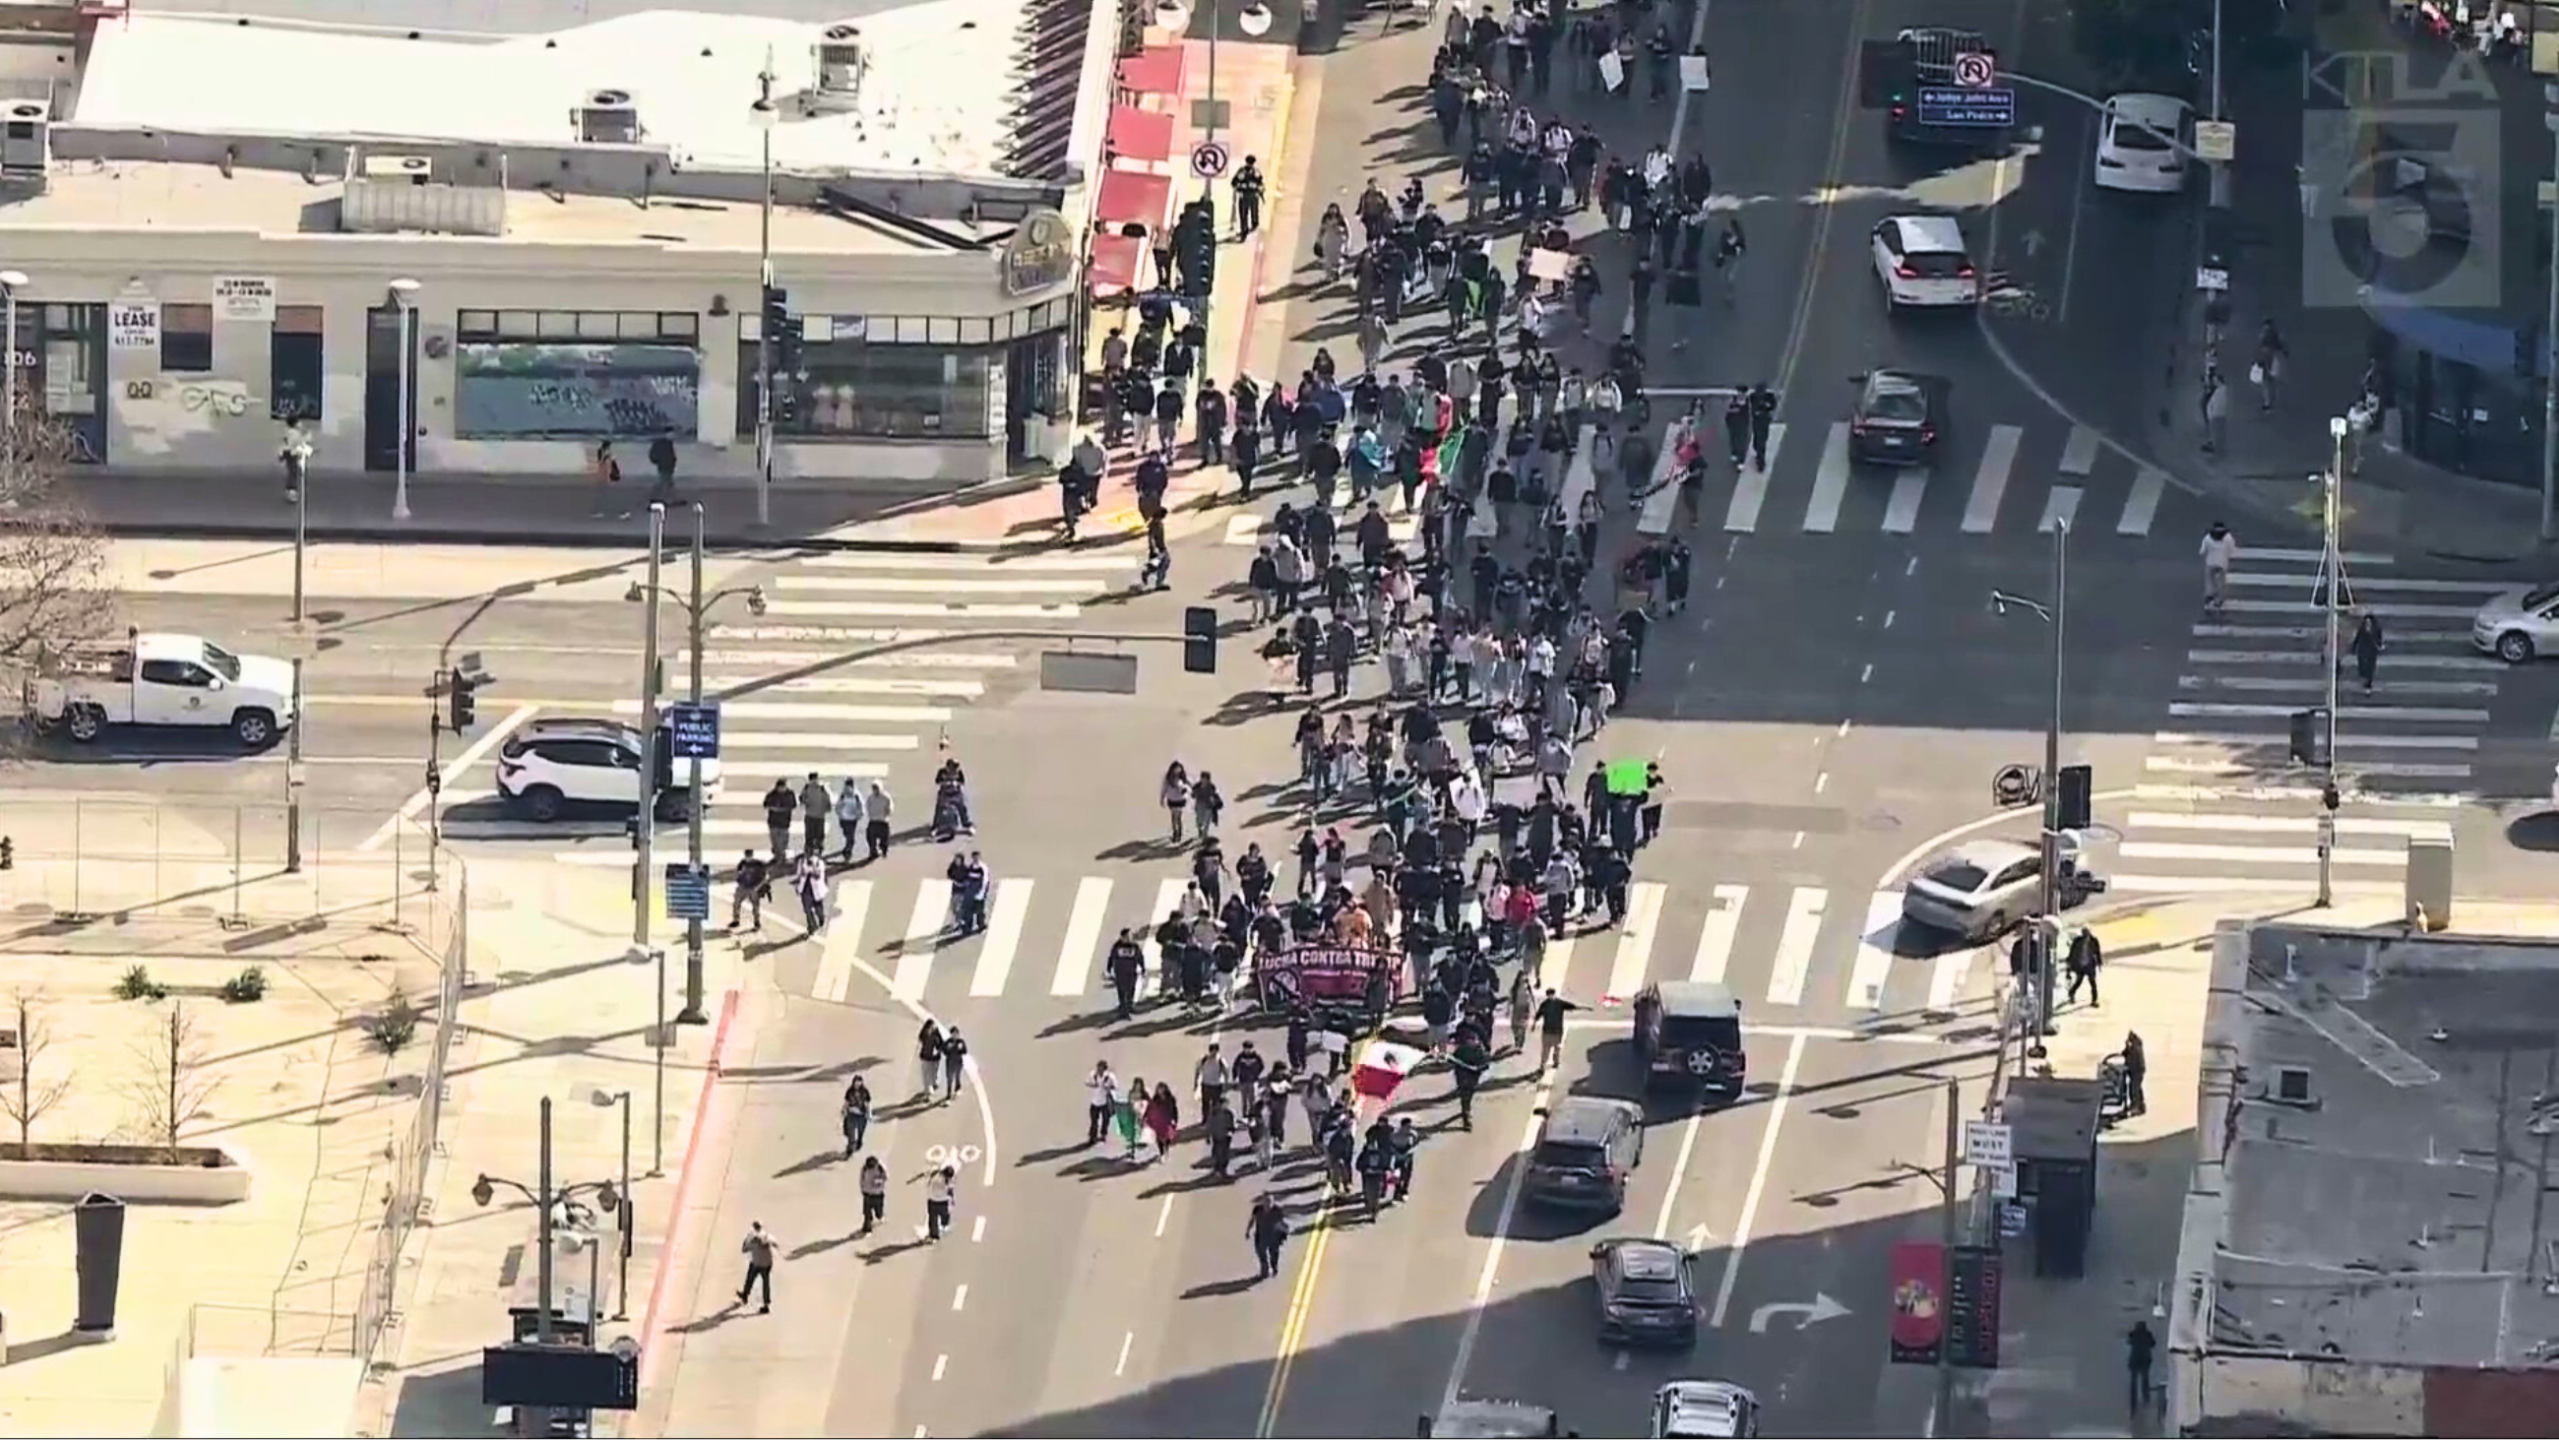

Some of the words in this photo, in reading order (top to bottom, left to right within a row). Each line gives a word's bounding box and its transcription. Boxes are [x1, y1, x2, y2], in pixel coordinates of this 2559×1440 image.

[114, 312, 156, 327] LEASE
[4, 351, 37, 366] 06
[678, 722, 711, 733] PUBLIC
[675, 732, 716, 743] PARKING
[1259, 953, 1298, 970] LUCHA
[1301, 951, 1351, 967] CONTRA
[1354, 951, 1401, 970] TRP
[1972, 1139, 2004, 1150] MUST
